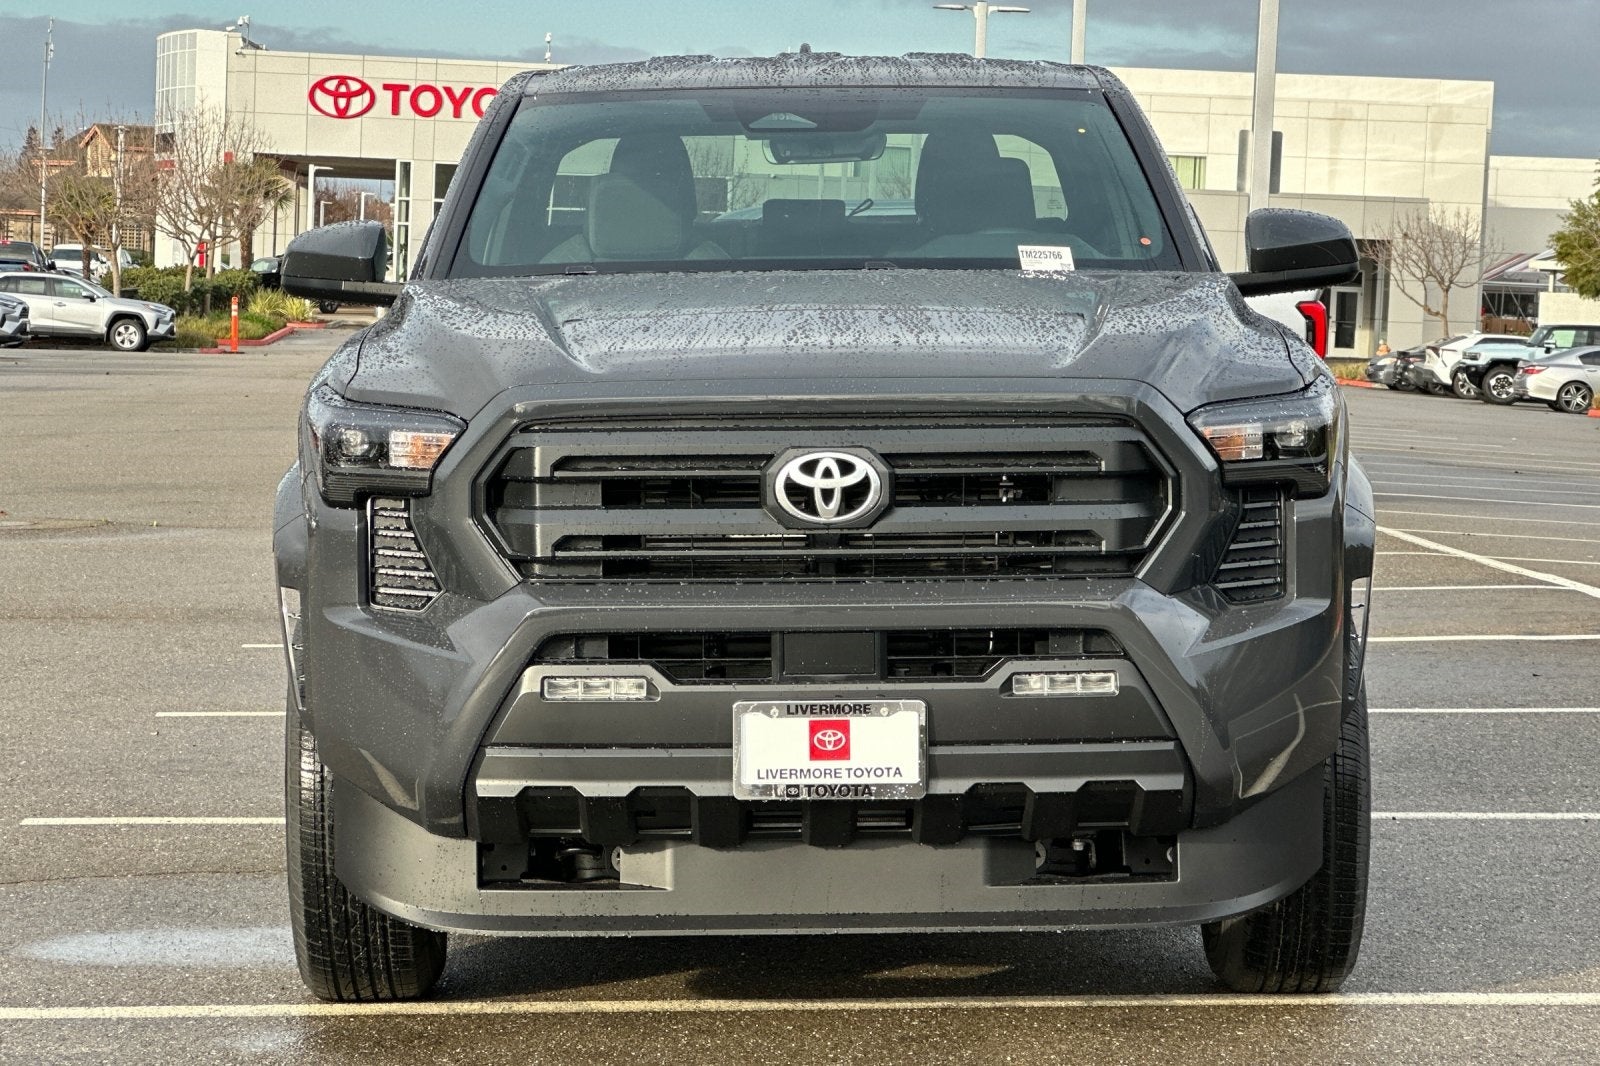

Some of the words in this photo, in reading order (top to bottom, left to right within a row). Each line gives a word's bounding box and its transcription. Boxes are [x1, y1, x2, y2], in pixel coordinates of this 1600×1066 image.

[1020, 250, 1063, 260] TM225766
[786, 703, 872, 716] LIVERMORE
[757, 768, 843, 780] LIVERMORE
[845, 767, 903, 778] TOYOTA
[804, 784, 873, 798] TOYOTA
